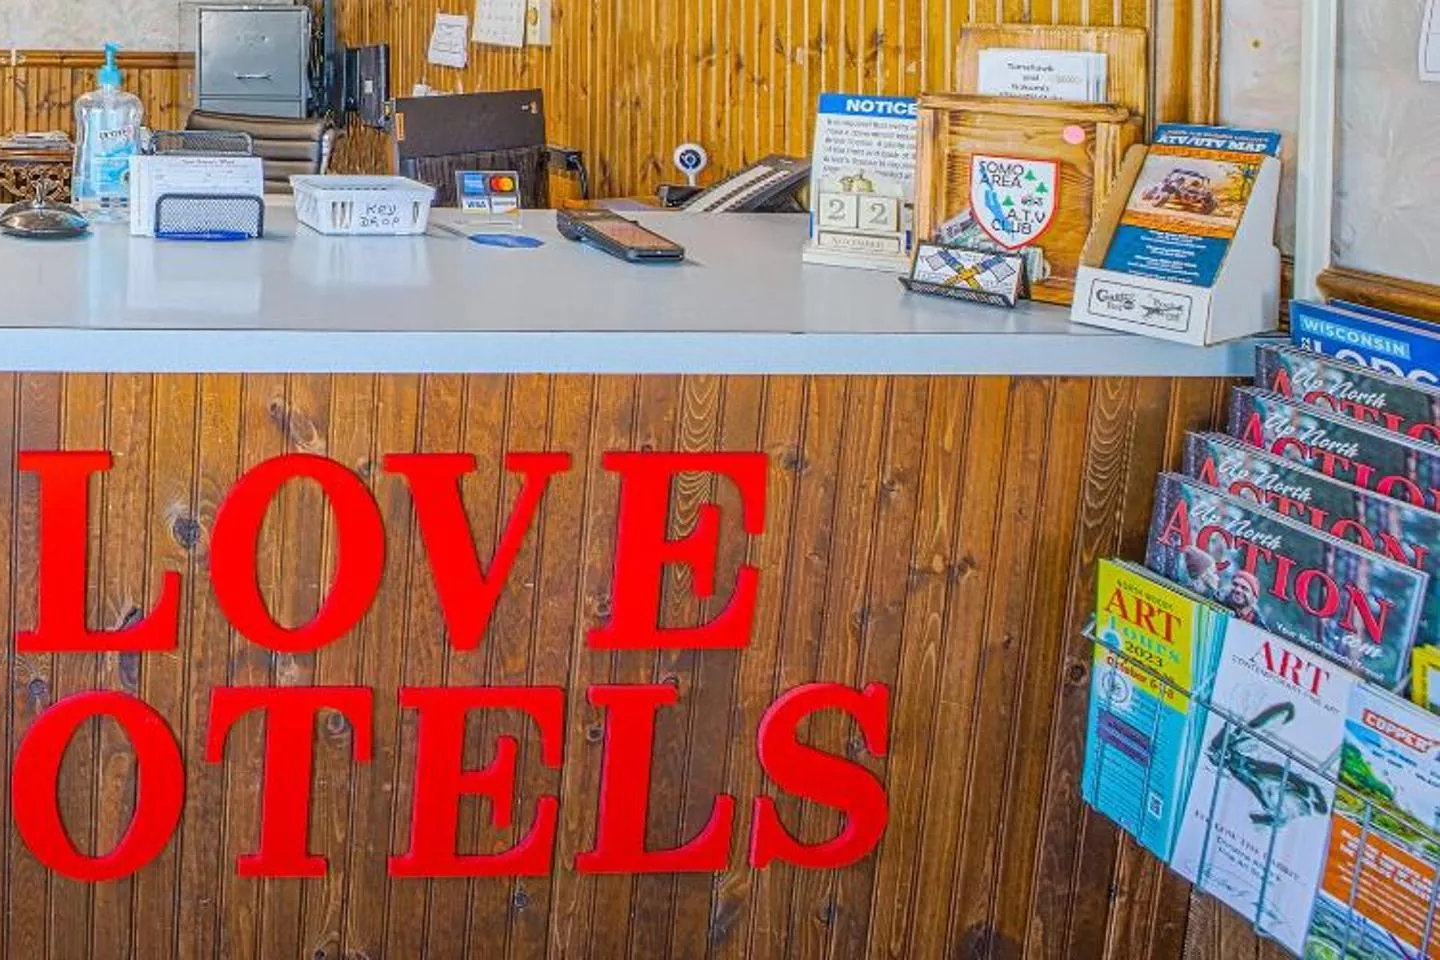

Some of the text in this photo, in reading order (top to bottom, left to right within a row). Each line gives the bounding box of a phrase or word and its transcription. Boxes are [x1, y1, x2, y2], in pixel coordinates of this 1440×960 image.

[846, 99, 918, 115] NOTICE
[1157, 134, 1228, 151] ATV/UTV
[1227, 140, 1266, 153] MAP
[979, 161, 1024, 175] SOMO
[980, 174, 1022, 189] AREA
[360, 215, 400, 228] DROP
[827, 198, 888, 225] 2 2
[991, 218, 1032, 235] CLUB
[1302, 317, 1406, 357] WISCONSIN
[1328, 379, 1388, 410] North
[1300, 424, 1360, 457] North
[1242, 412, 1440, 512] ACTIO
[1257, 468, 1313, 502] North
[1226, 515, 1283, 551] North
[16, 449, 769, 654] LOVE
[1158, 499, 1394, 645] ACTION
[1104, 587, 1183, 645] ART
[1247, 639, 1330, 697] ART
